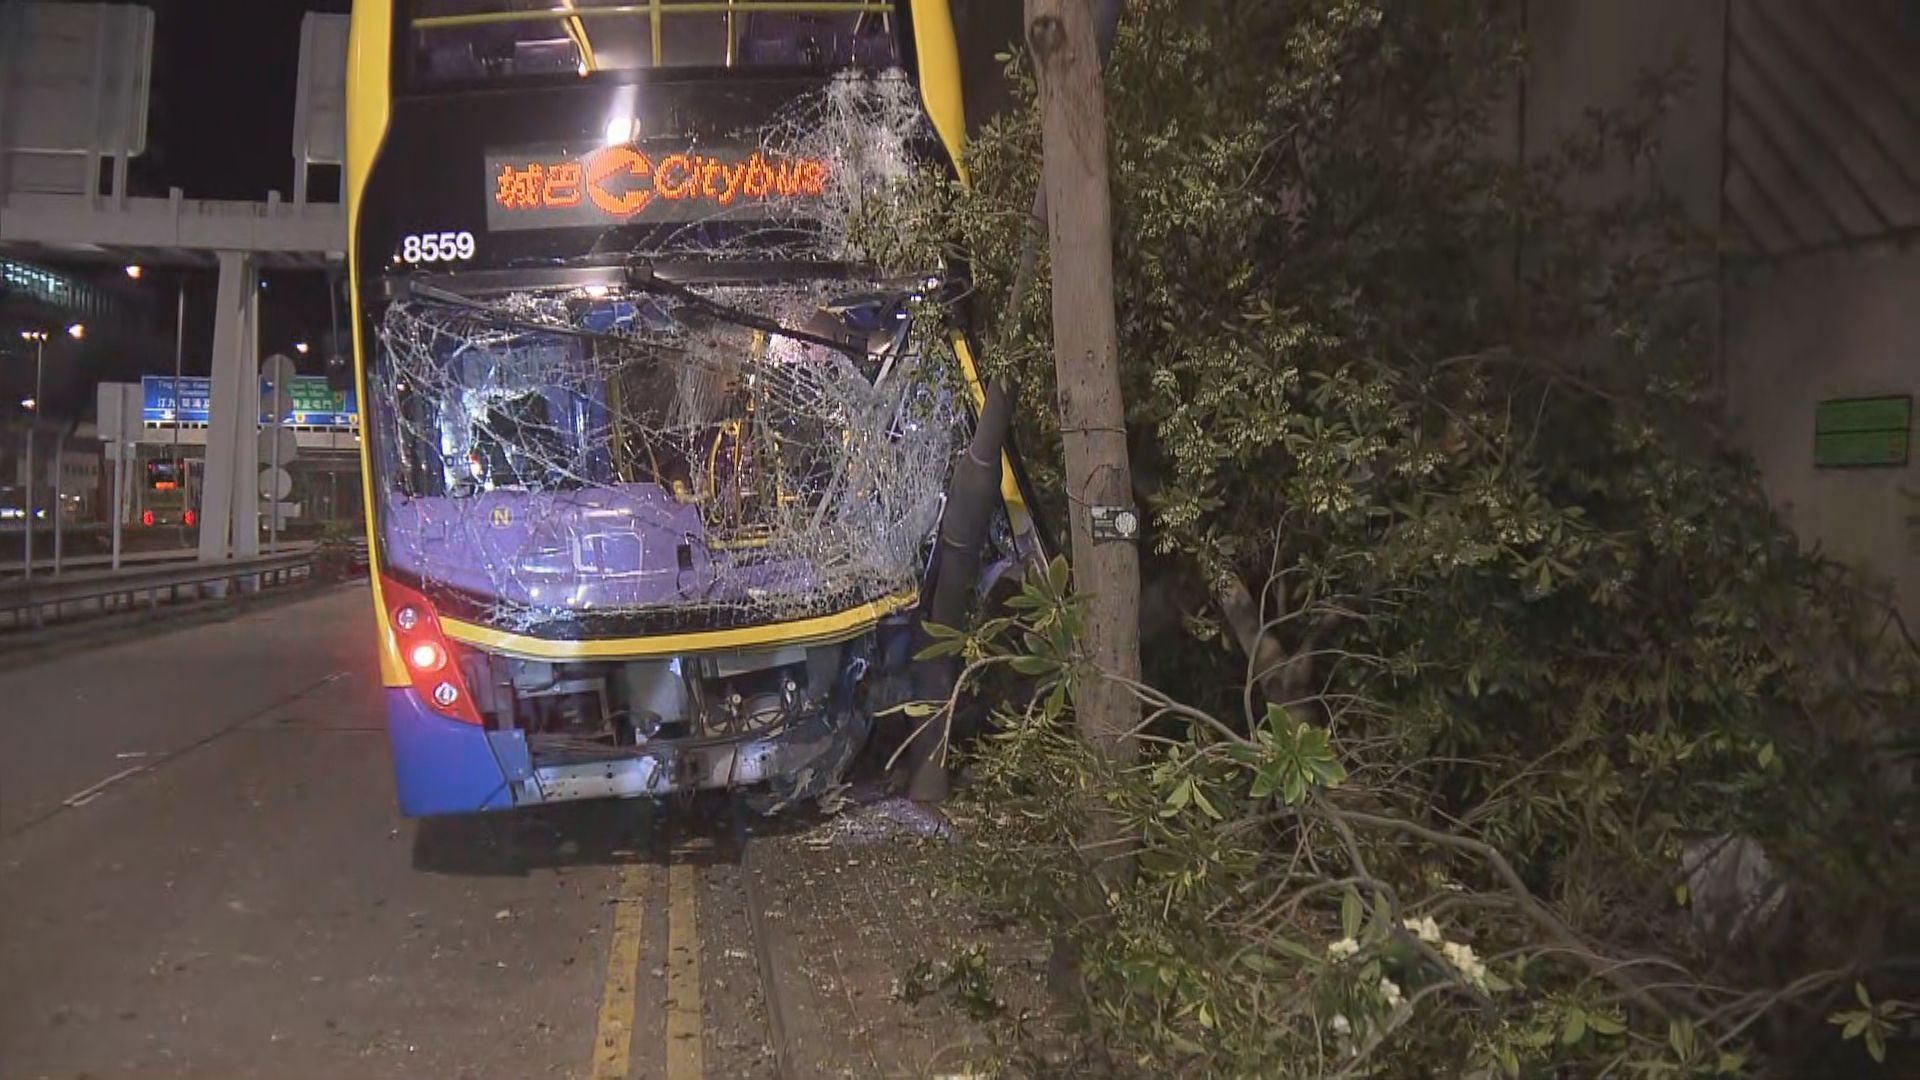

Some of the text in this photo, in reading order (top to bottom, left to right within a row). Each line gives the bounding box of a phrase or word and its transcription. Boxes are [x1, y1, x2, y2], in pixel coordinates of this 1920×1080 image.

[495, 164, 582, 208] 城巴
[653, 153, 825, 206] Citybus
[402, 232, 475, 263] 8559
